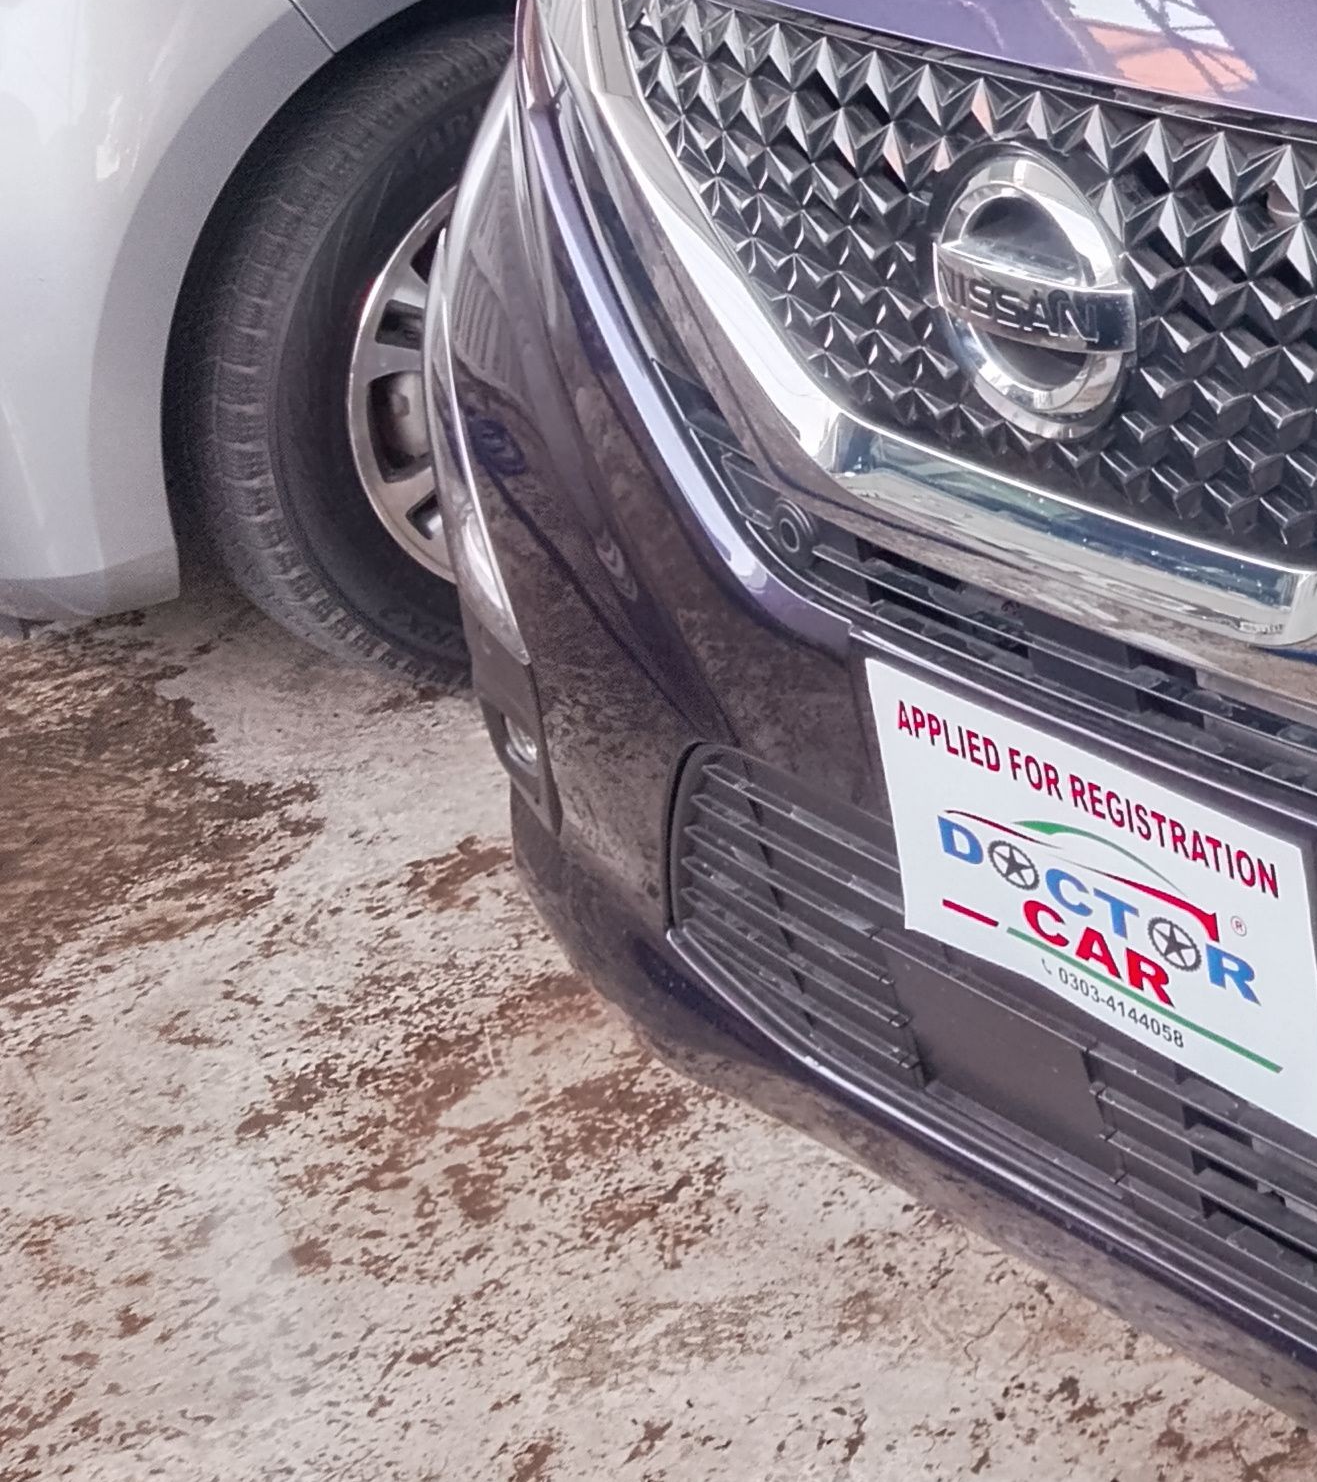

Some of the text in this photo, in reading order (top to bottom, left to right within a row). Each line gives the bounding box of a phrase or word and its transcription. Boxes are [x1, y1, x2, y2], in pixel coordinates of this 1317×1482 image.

[898, 699, 1280, 900] APPLIED FOR REGISTRATION
[1023, 899, 1175, 1009] CAR
[1058, 966, 1185, 1050] 0303-4144058
